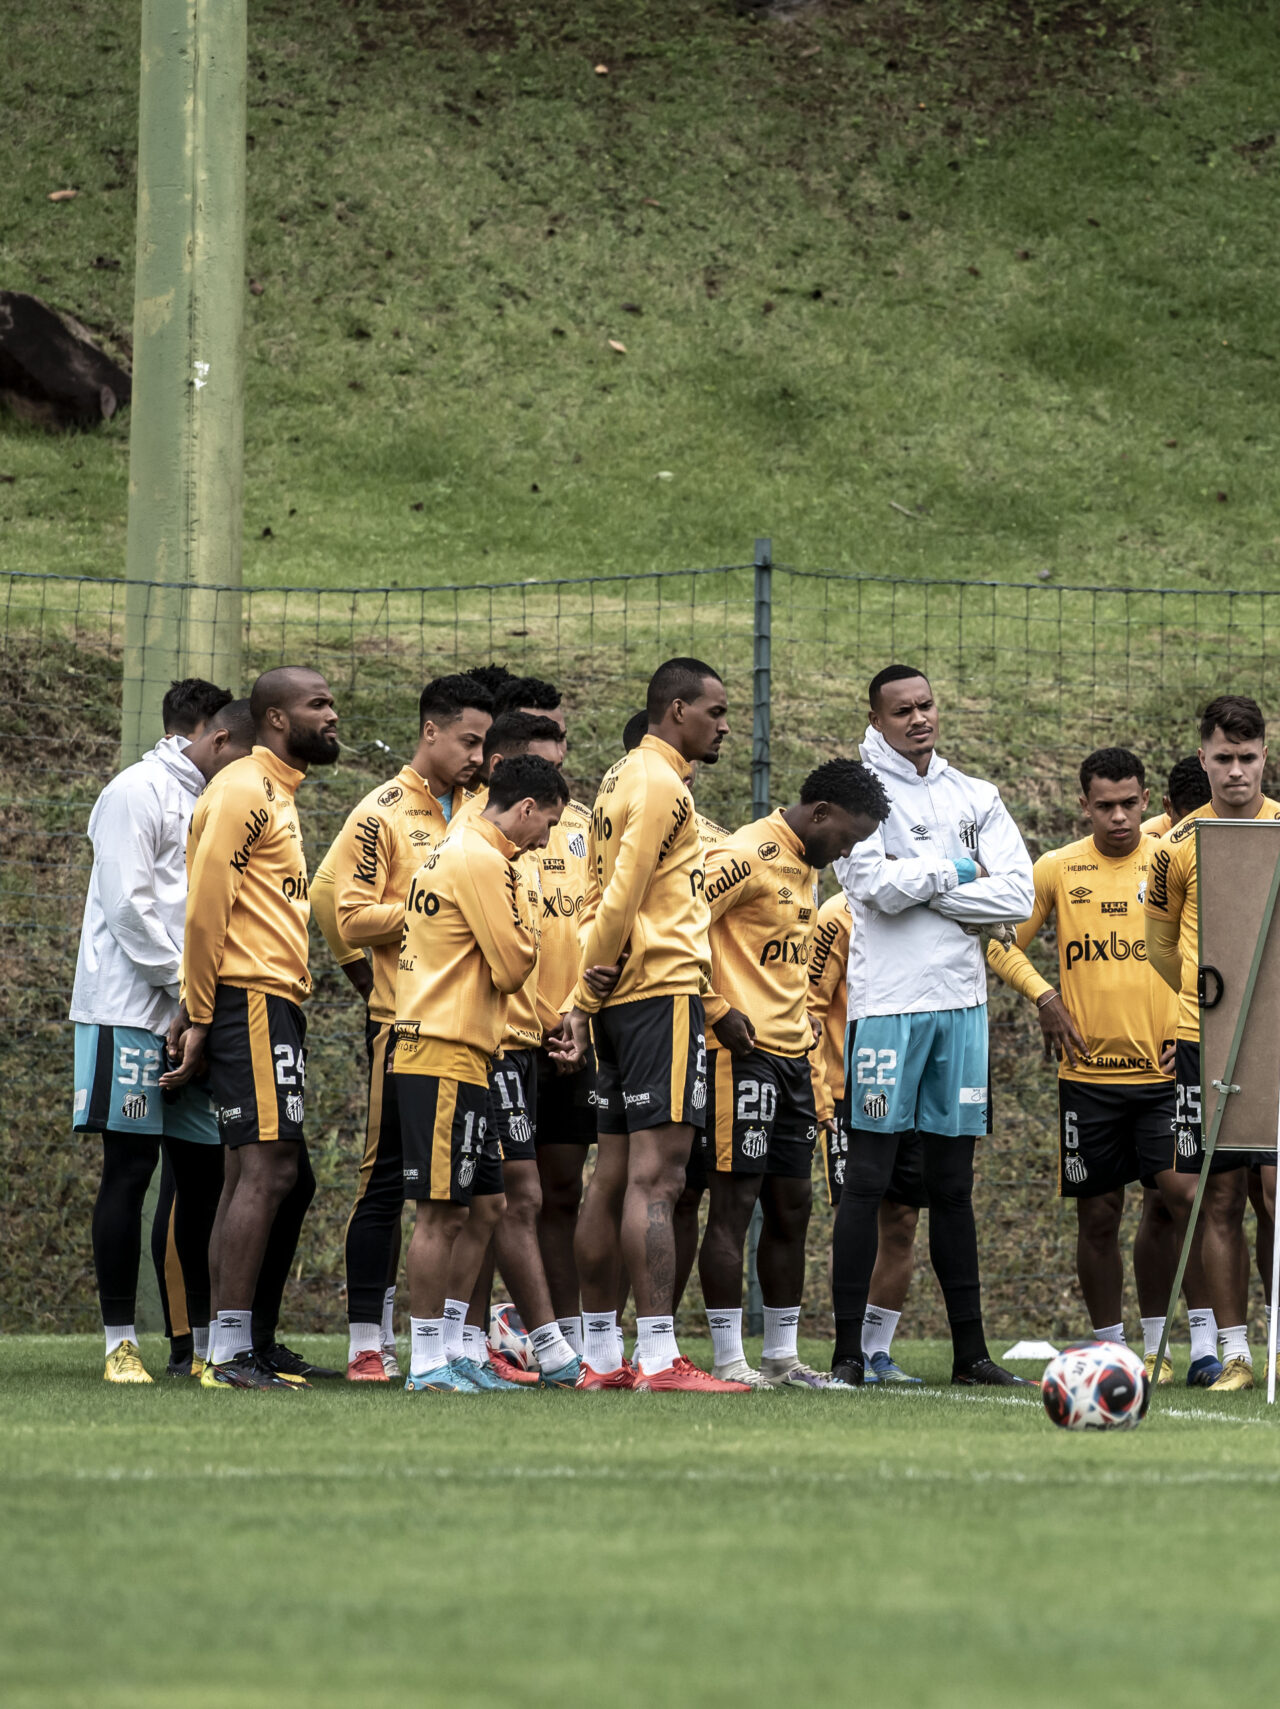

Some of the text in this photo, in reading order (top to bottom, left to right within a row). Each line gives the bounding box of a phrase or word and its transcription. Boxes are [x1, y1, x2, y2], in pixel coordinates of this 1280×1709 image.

[230, 808, 269, 875] Kicaldo
[353, 816, 380, 886] Kicaldo
[705, 858, 752, 905] icaldo
[1067, 864, 1099, 872] HEBRON
[1147, 849, 1172, 913] Kicaldo
[118, 1047, 160, 1087] 52
[274, 1044, 305, 1087] 24
[857, 1047, 897, 1085] 22
[1095, 1056, 1154, 1069] BINANCE
[494, 1071, 526, 1109] 17
[738, 1080, 776, 1121] 20
[1065, 1110, 1079, 1149] 6
